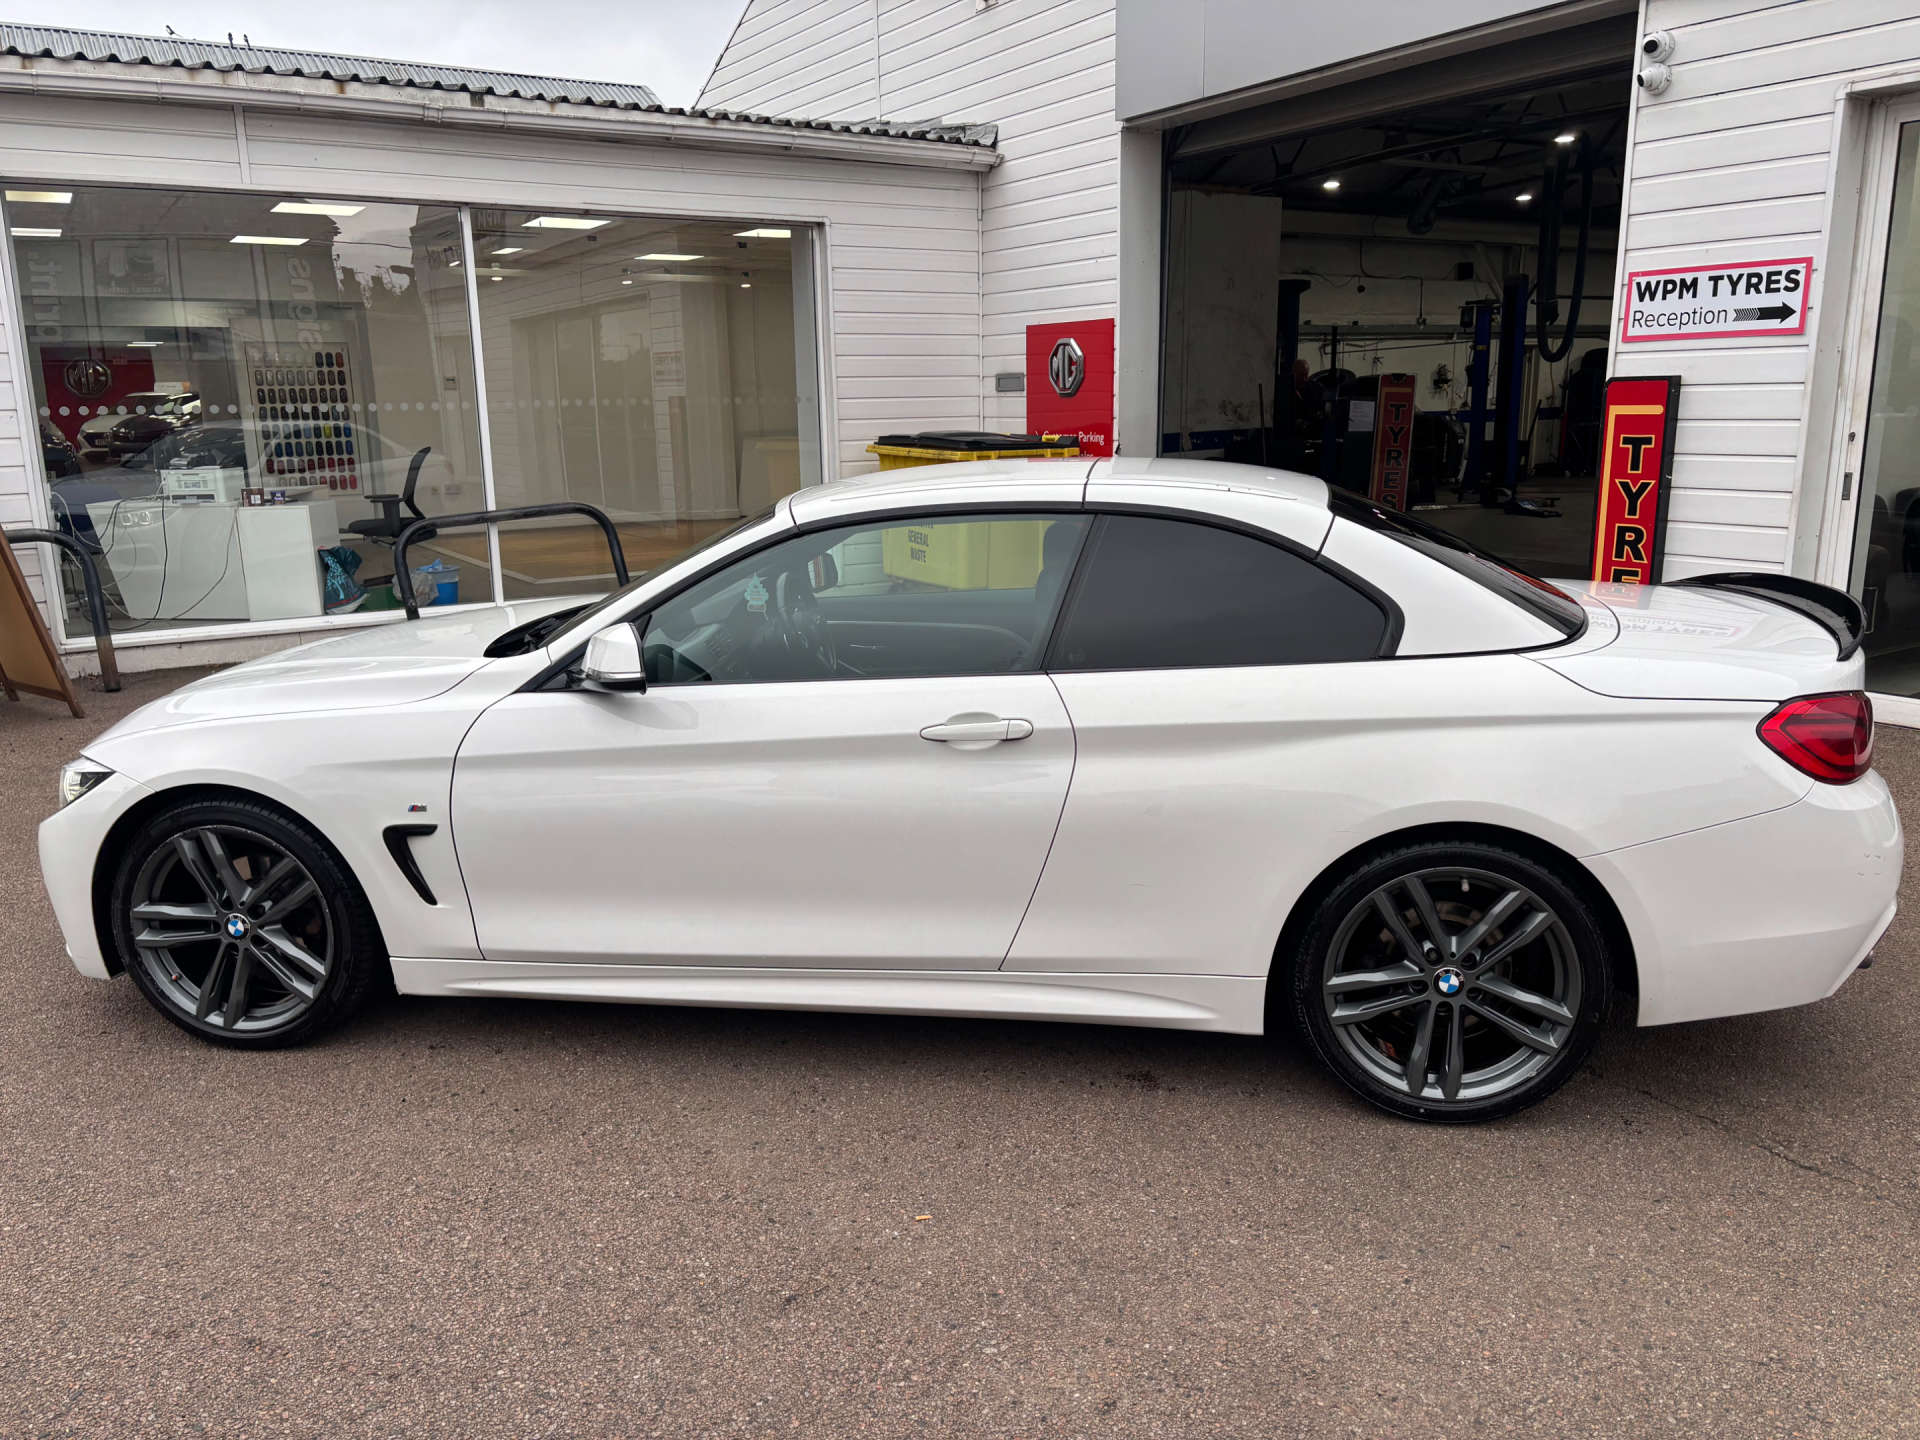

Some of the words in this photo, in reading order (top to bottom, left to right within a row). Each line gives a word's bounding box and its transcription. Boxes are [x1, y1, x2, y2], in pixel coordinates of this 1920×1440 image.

[1635, 276, 1699, 303] WPM
[1708, 269, 1801, 298] TYRES
[1631, 307, 1728, 331] Reception
[1051, 341, 1081, 392] MG
[1078, 431, 1104, 446] Parking
[908, 529, 929, 547] GENERAL
[911, 547, 927, 563] WASTE
